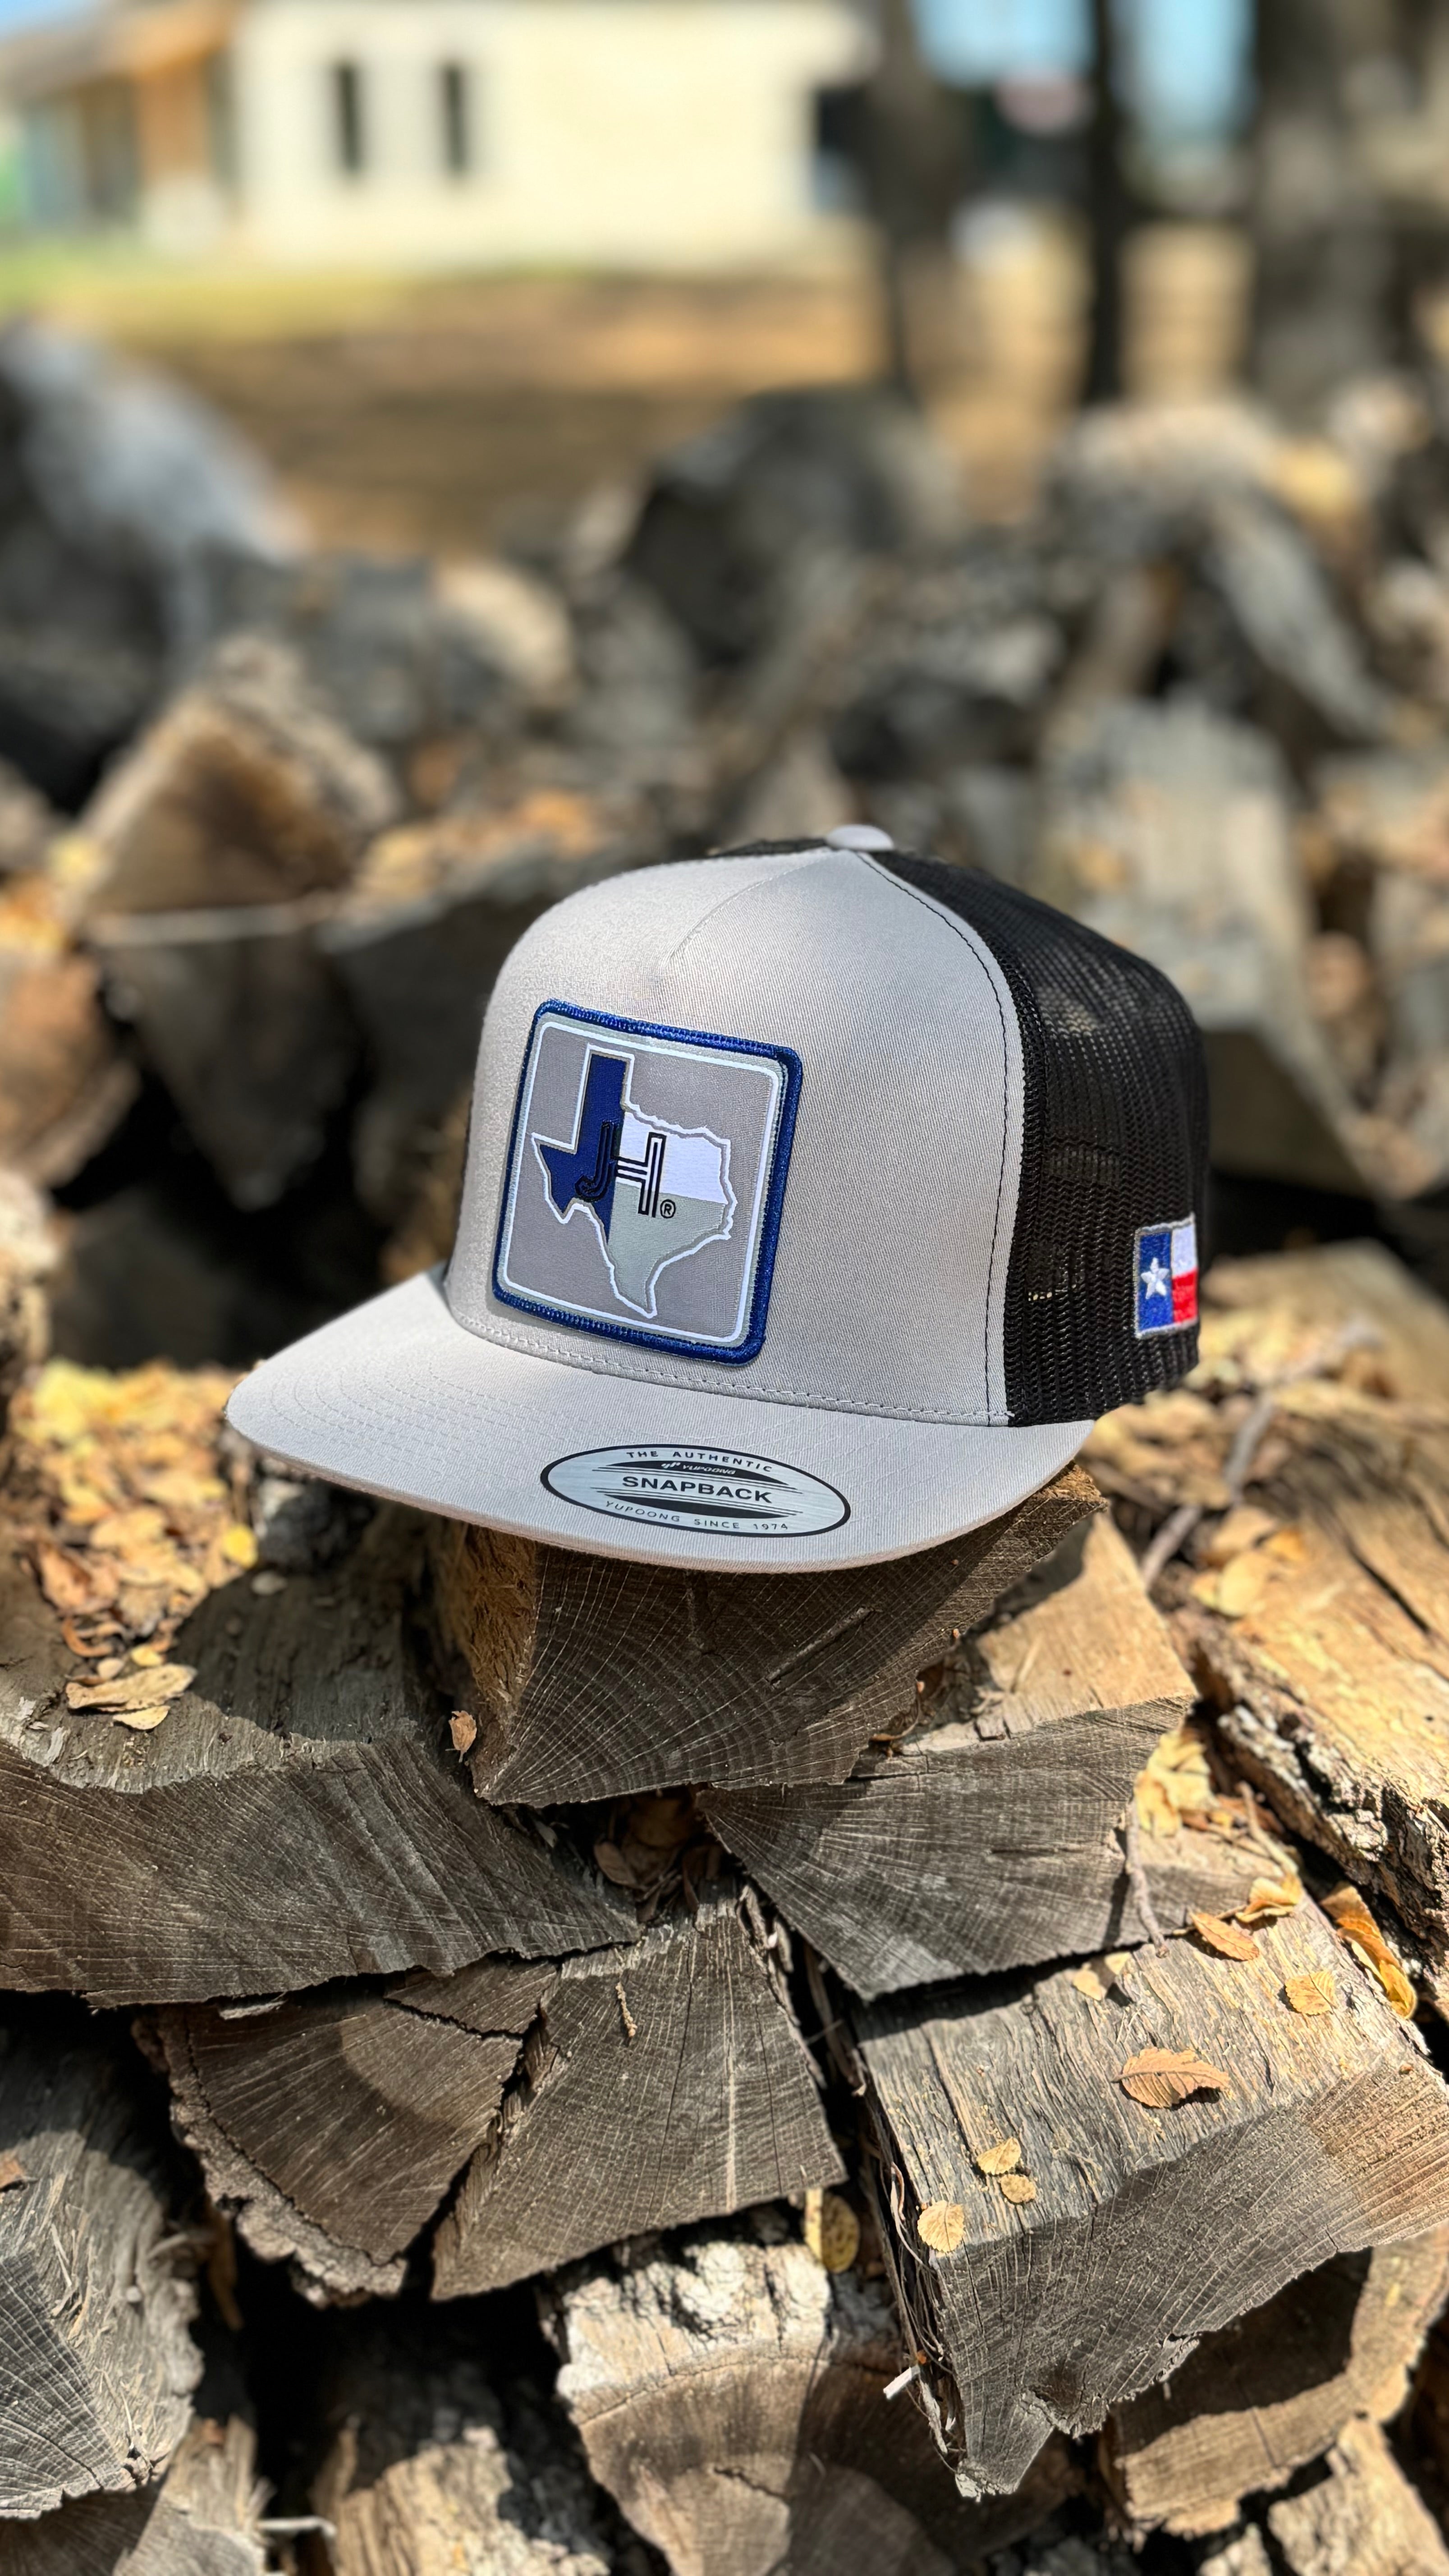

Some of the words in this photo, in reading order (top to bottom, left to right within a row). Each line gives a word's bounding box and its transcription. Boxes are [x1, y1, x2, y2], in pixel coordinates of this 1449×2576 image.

[626, 1450, 659, 1458] THE
[672, 1451, 773, 1472] AUTHENTIC
[622, 1476, 772, 1504] SNAPBACK
[605, 1500, 680, 1523] YUPOONG
[693, 1518, 740, 1530] SINCE
